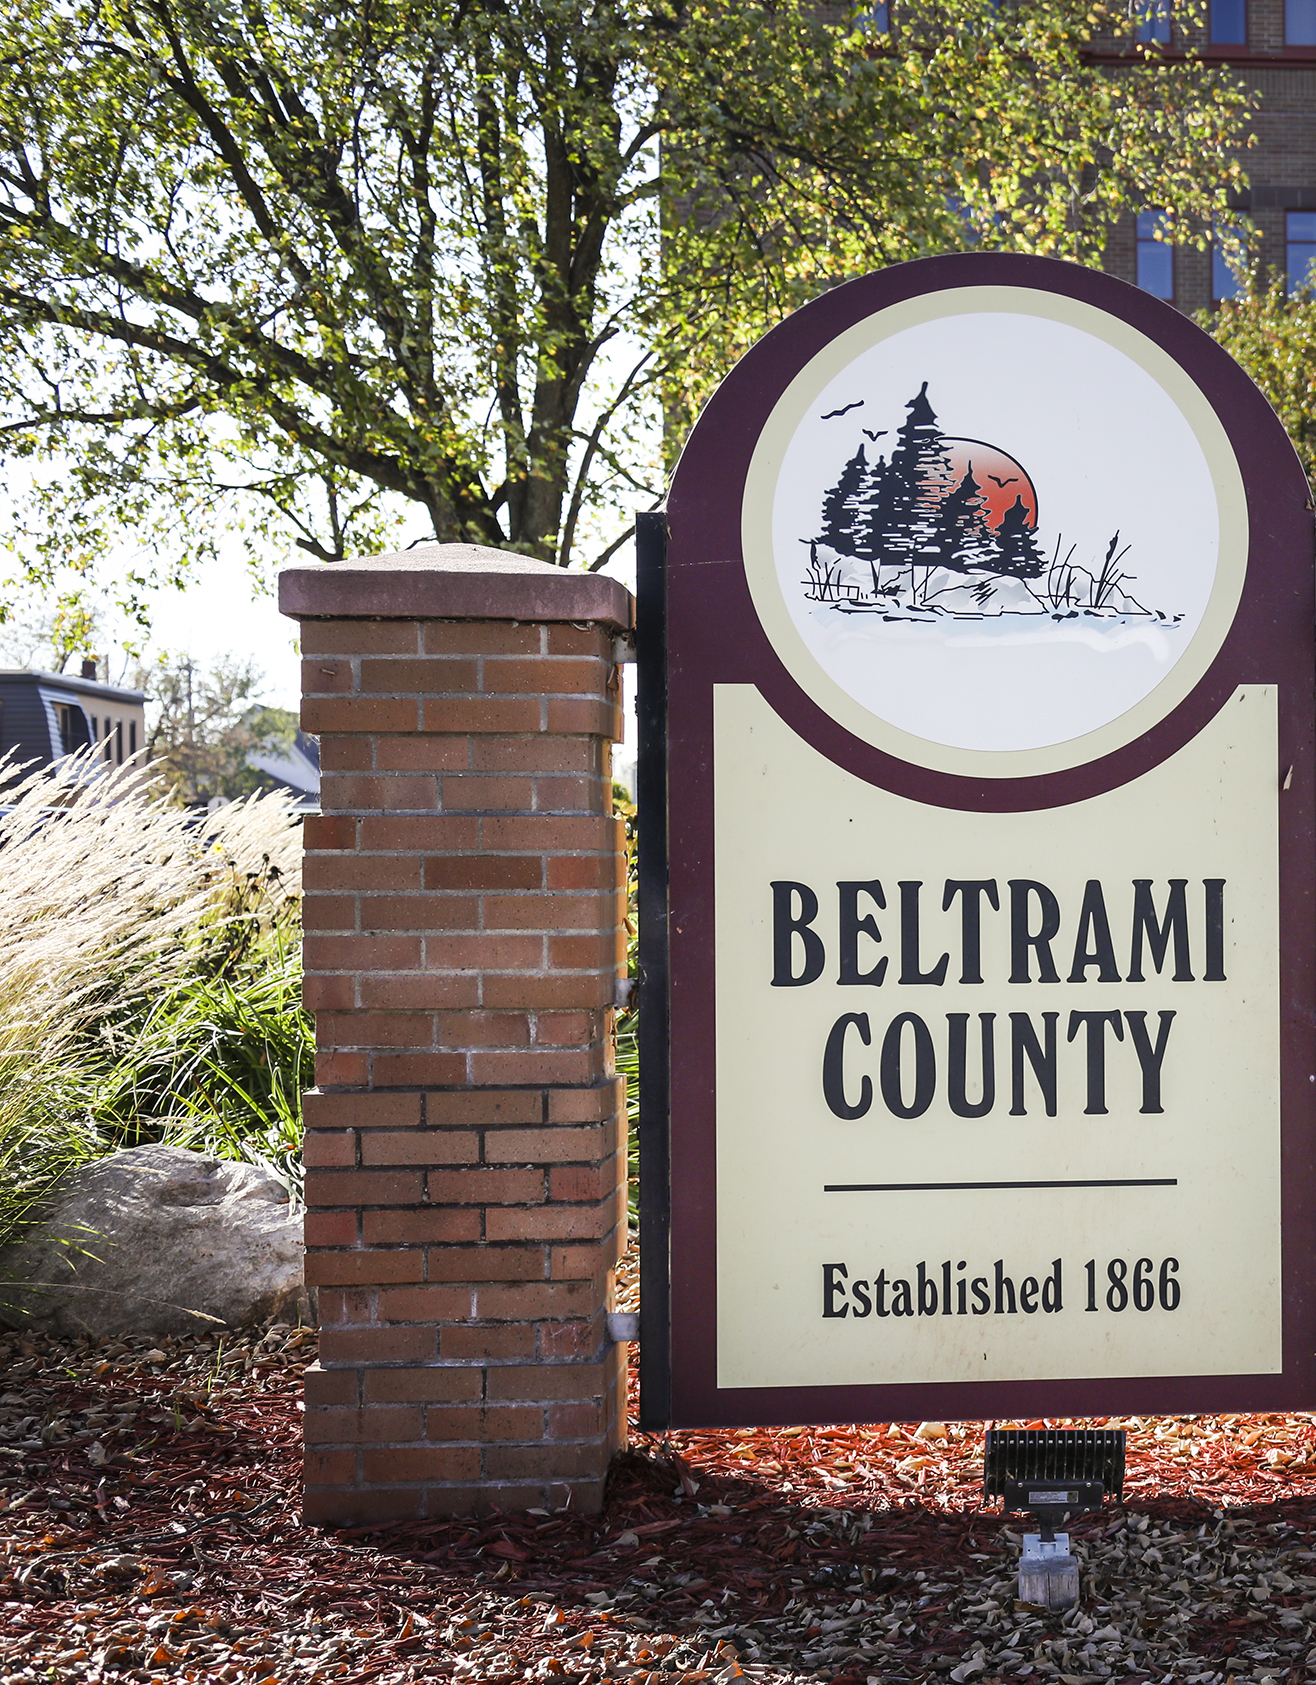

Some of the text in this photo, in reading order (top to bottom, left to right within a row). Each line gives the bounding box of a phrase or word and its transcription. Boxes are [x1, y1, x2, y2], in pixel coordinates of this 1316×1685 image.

[769, 878, 1228, 988] BELTRAMI
[822, 1008, 1177, 1121] COUNTY
[821, 1257, 1181, 1319] Established 1866
